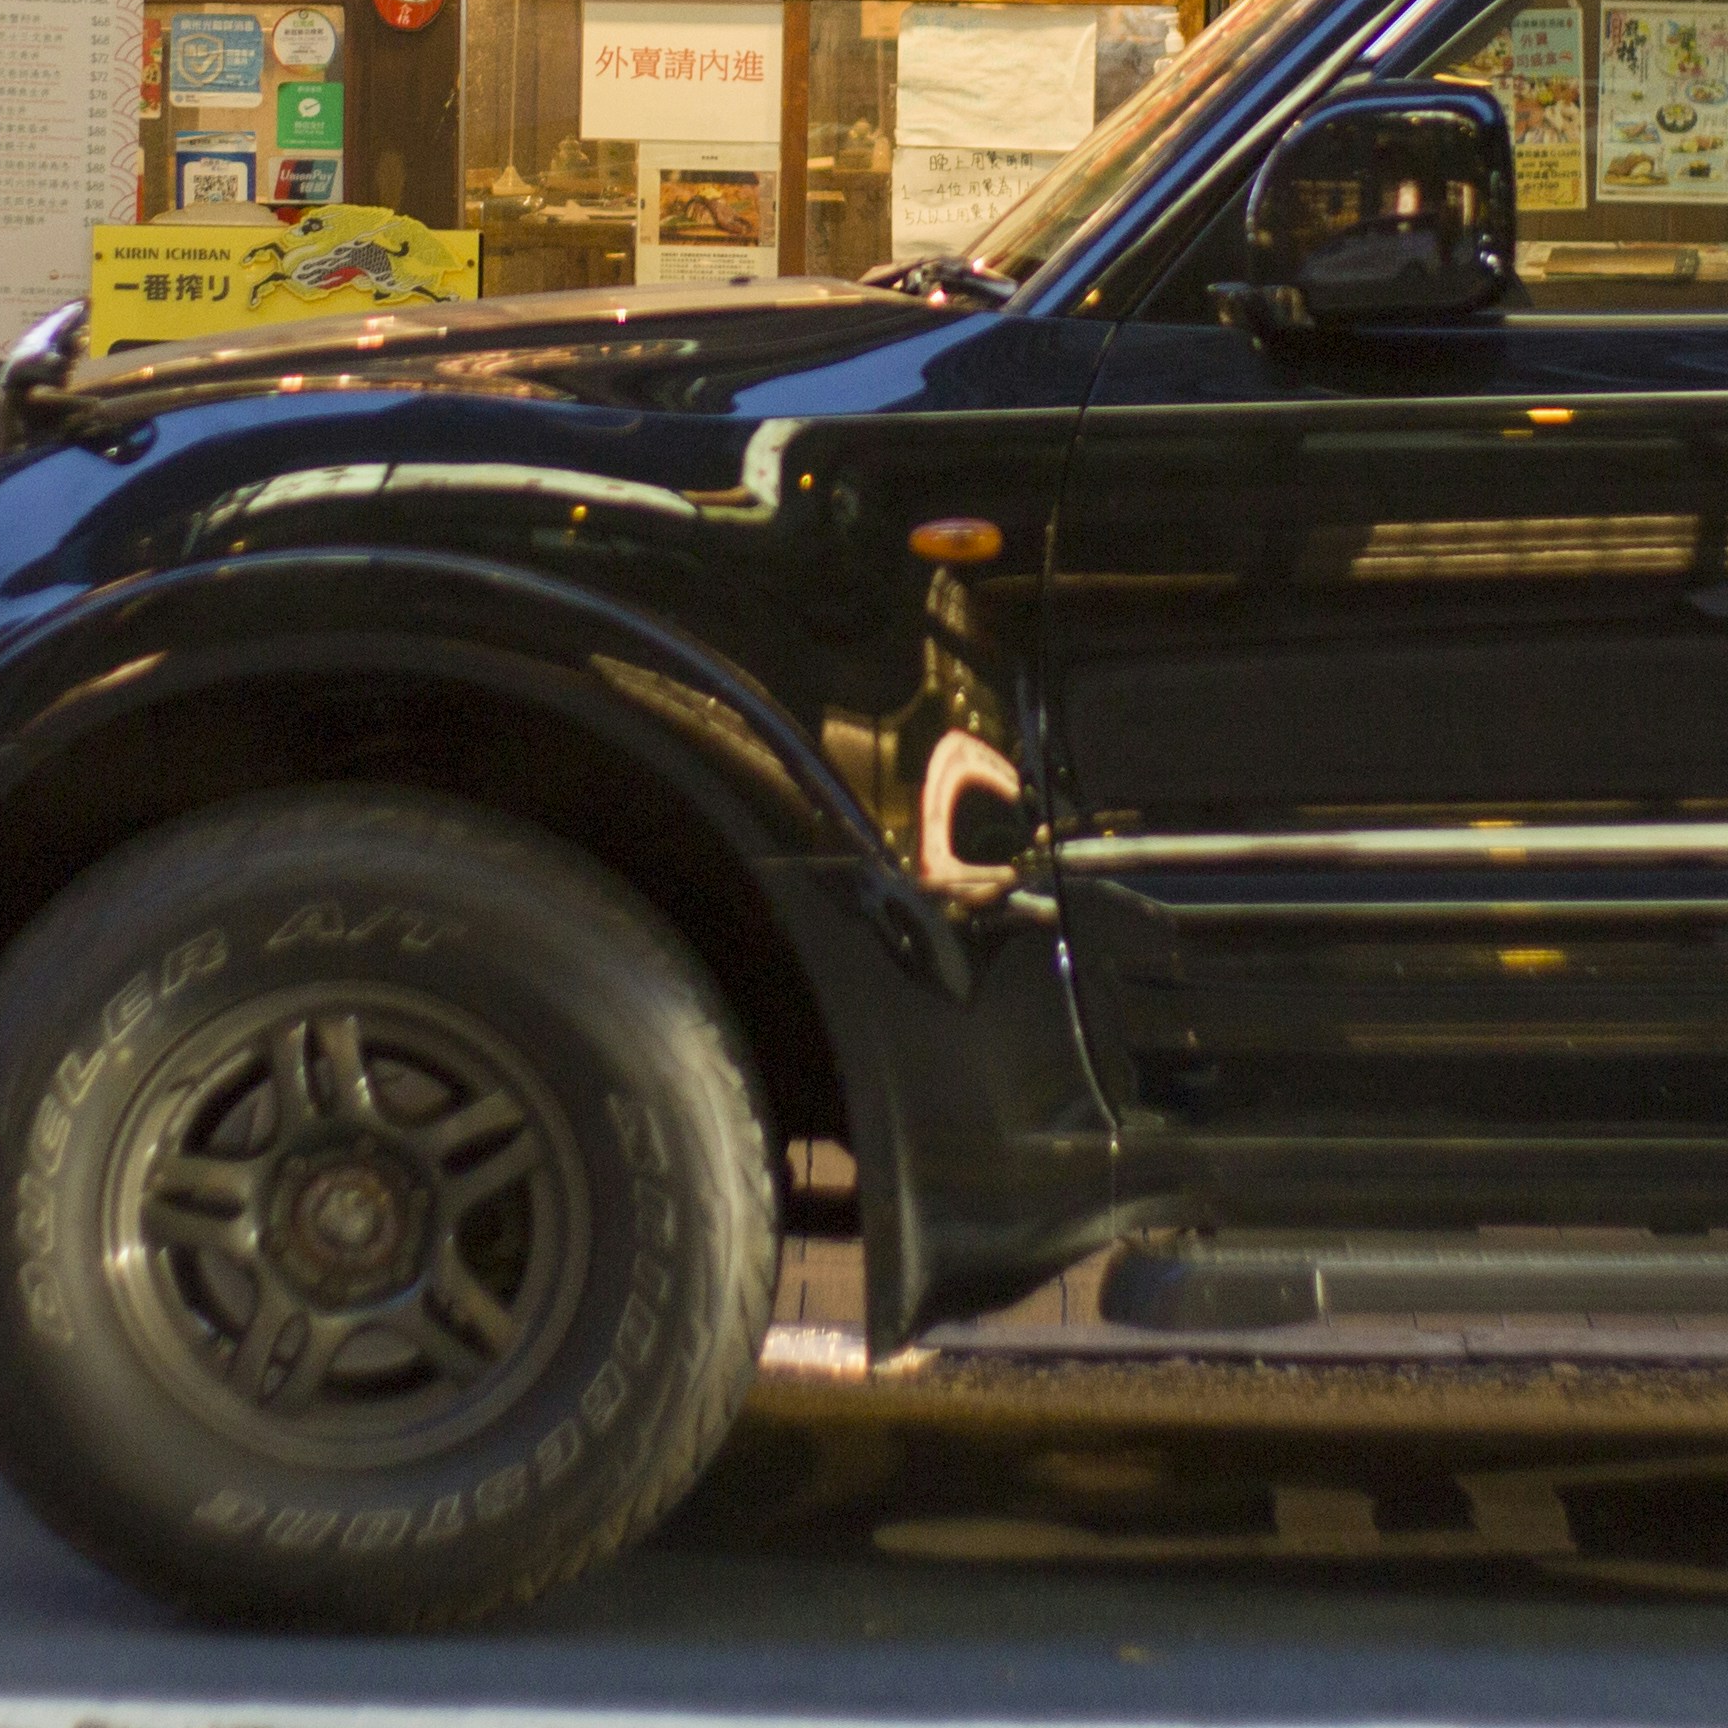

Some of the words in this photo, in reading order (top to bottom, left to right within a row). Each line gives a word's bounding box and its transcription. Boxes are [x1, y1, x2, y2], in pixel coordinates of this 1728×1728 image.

[594, 45, 765, 84] 外賣請內進
[280, 169, 333, 184] UnionPay
[114, 246, 160, 261] KIRIN
[166, 247, 231, 262] ICHIBAN
[114, 272, 230, 302] 一番搾り
